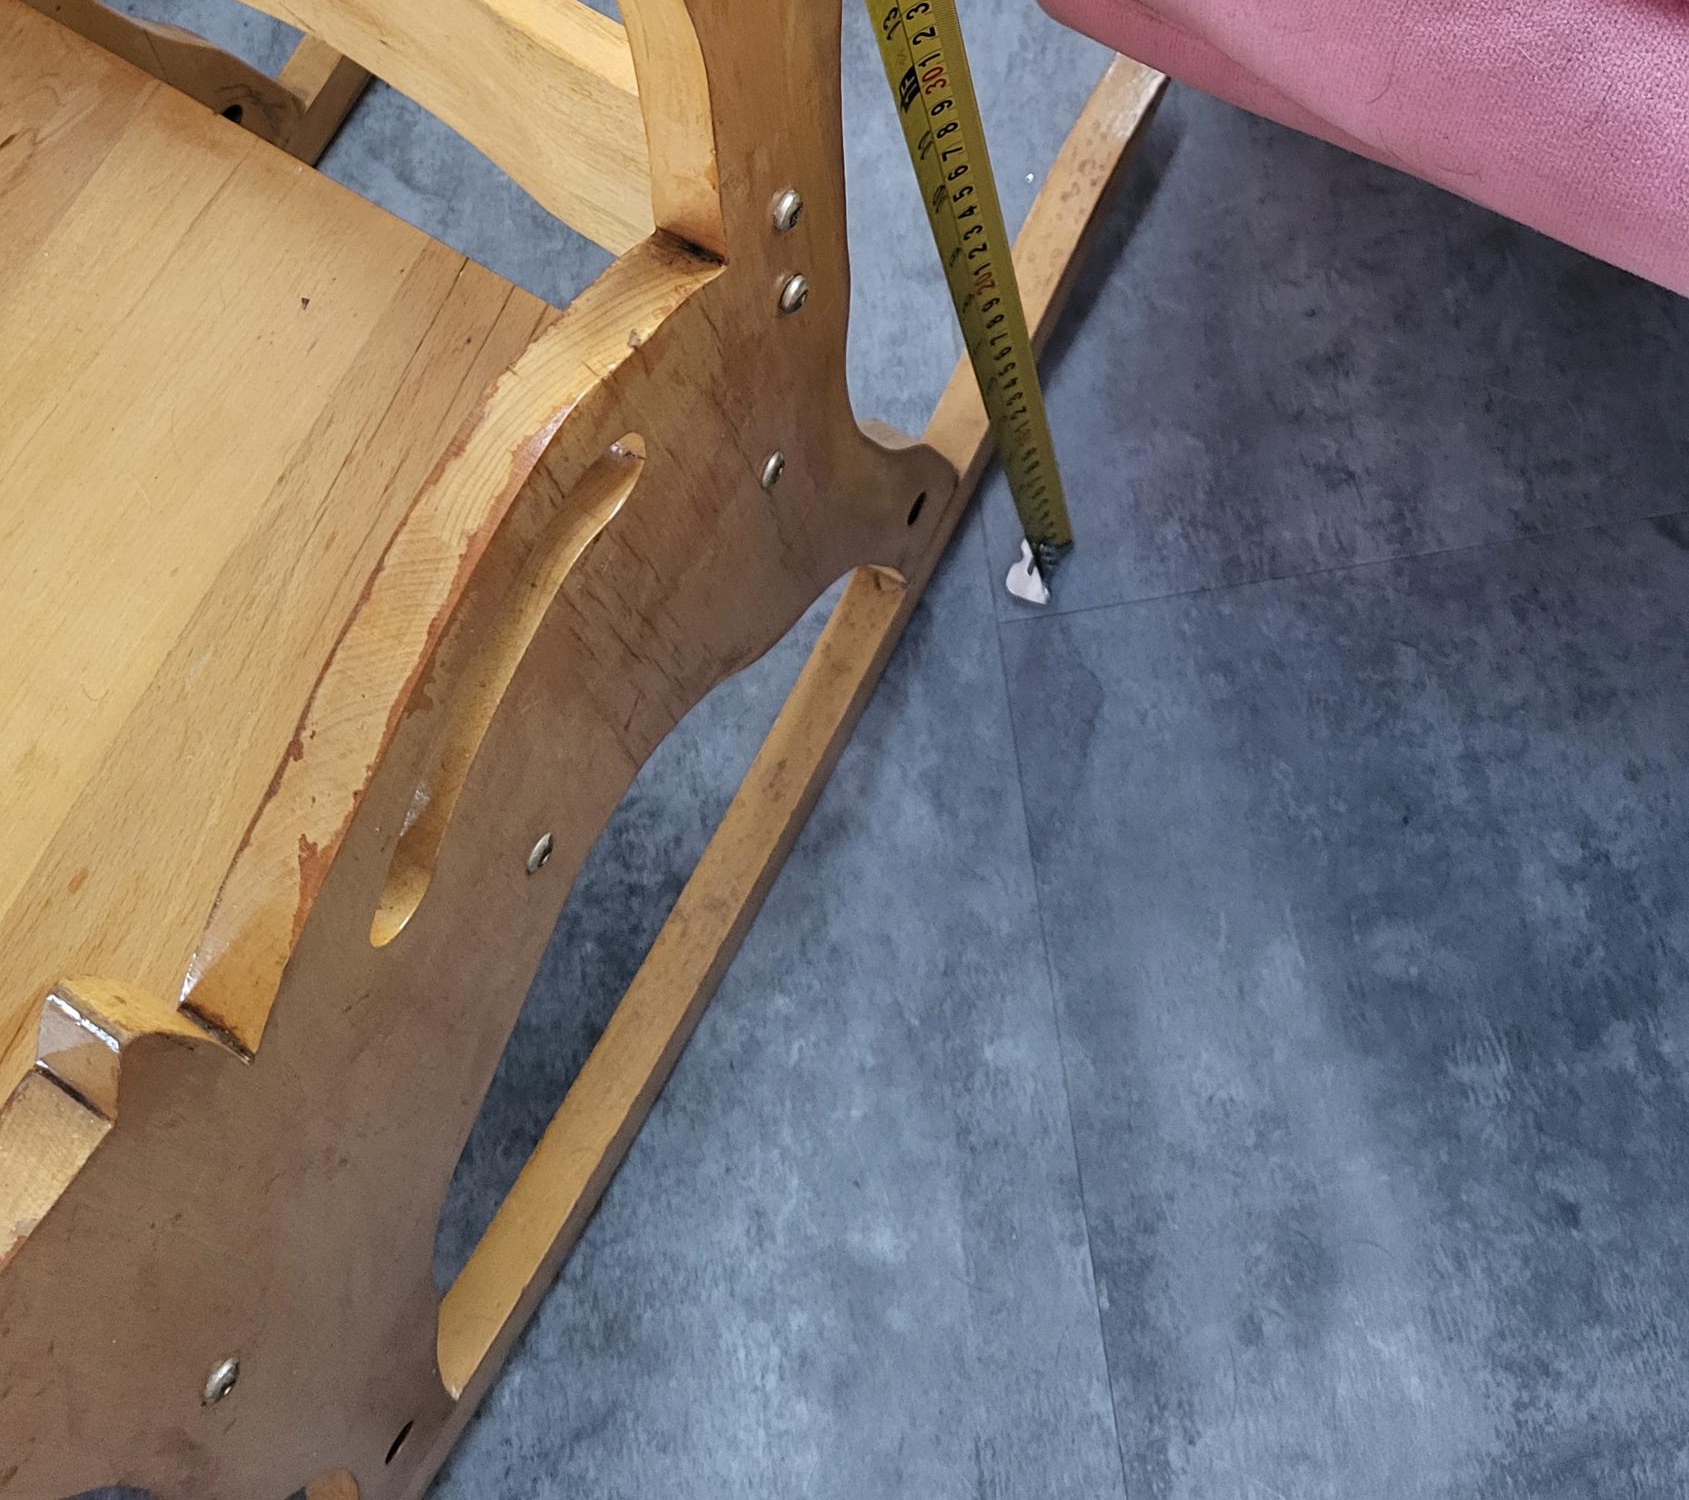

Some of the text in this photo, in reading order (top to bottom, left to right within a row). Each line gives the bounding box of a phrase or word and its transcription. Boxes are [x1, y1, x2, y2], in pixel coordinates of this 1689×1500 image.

[905, 2, 930, 20] 3
[883, 7, 902, 40] 13
[912, 26, 936, 45] 2
[918, 52, 941, 67] 1
[921, 66, 947, 95] 30
[931, 99, 953, 116] 9
[936, 122, 958, 139] 8
[918, 130, 934, 161] 11
[942, 146, 963, 162] 7
[948, 165, 968, 181] 6
[953, 185, 974, 202] 5
[958, 205, 977, 219] 4
[963, 225, 983, 241] 3
[968, 243, 988, 260] 2
[973, 262, 991, 276] 1
[975, 271, 995, 295] 20
[982, 297, 1000, 313] 9
[986, 314, 1005, 329] 8
[991, 332, 1008, 346] 7
[999, 361, 1016, 376] 5
